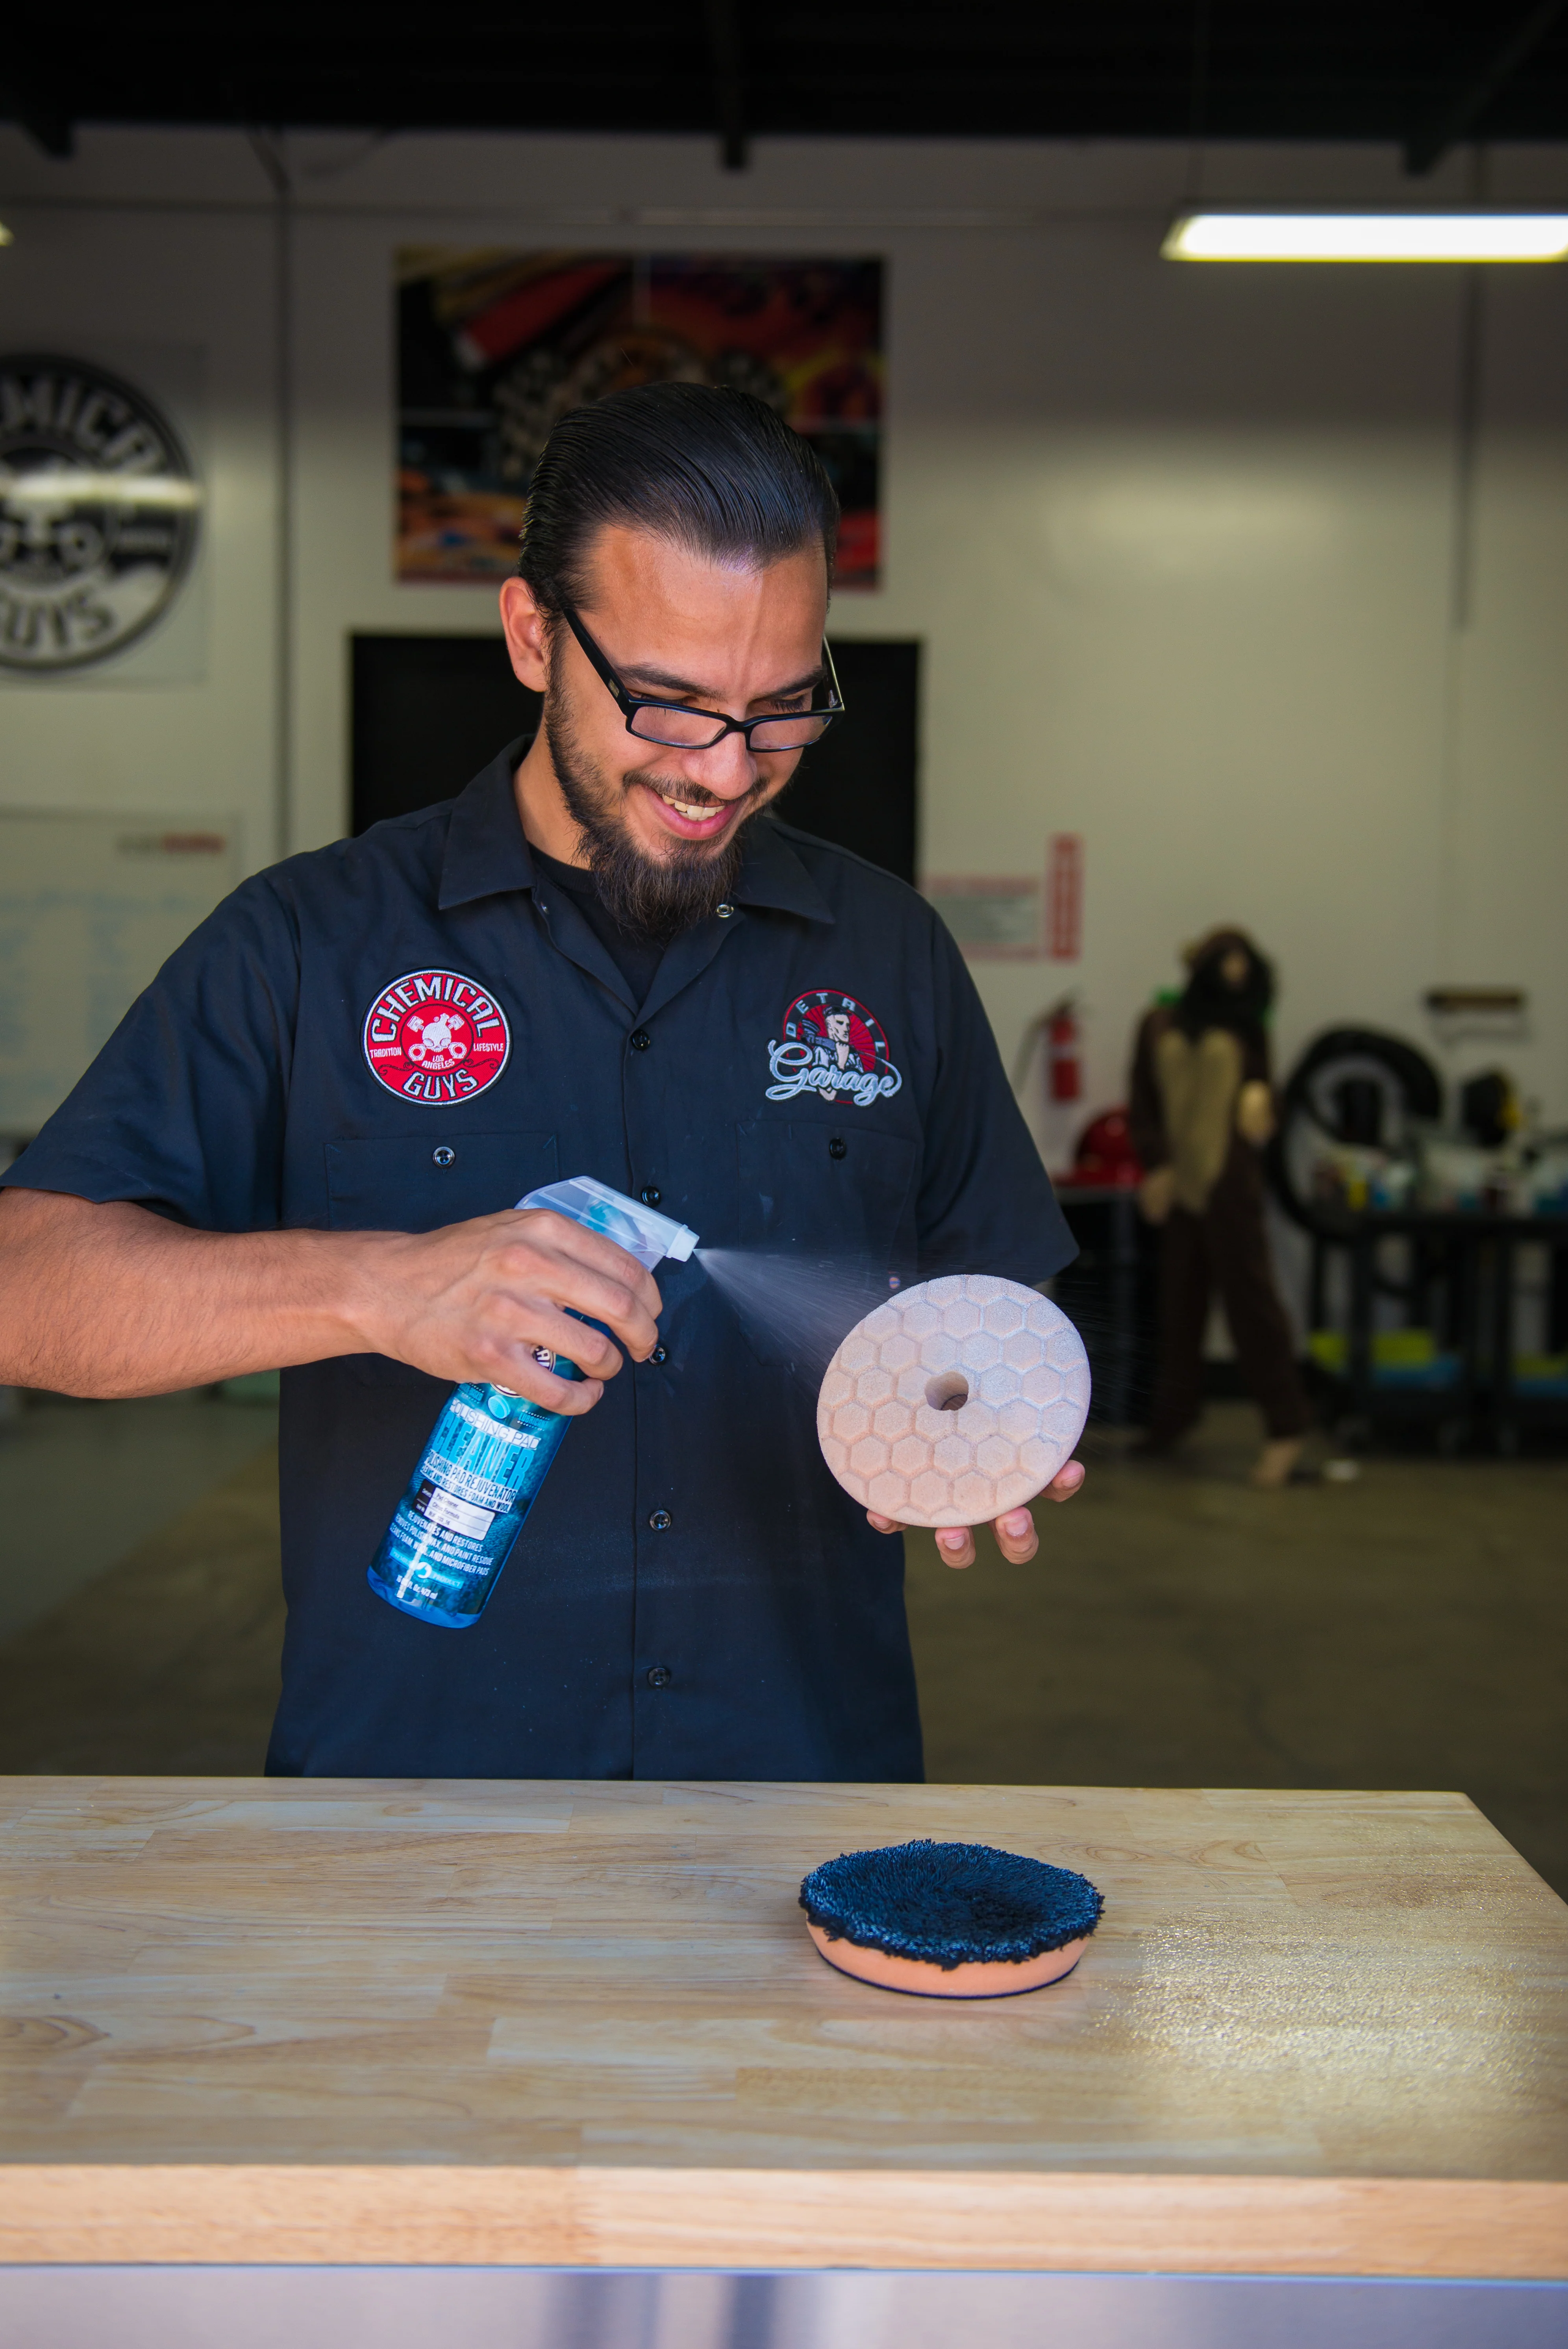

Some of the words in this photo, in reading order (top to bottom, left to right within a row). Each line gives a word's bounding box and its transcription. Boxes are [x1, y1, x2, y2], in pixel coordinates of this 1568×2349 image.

[371, 976, 500, 1042] CHEMICAL
[786, 993, 885, 1052] DETAIL
[370, 1047, 402, 1058] TRADITION
[422, 1058, 455, 1069] ANGELES
[473, 1043, 504, 1052] LIFESTYLE
[402, 1069, 479, 1099] GUYS
[765, 1040, 902, 1106] Garage
[450, 1399, 510, 1439] POLISHING
[512, 1431, 540, 1449] PAD
[431, 1410, 535, 1490] CLEANER
[441, 1478, 468, 1497] RESTORES
[467, 1491, 485, 1504] FOAM
[484, 1497, 496, 1508] AND
[496, 1502, 510, 1512] WOOL
[450, 1467, 467, 1484] PAD
[464, 1474, 516, 1502] REJUVENATOR
[407, 1510, 442, 1536] REJUVENATES
[439, 1530, 454, 1542] AND
[452, 1535, 483, 1552] RESTORES
[408, 1525, 428, 1542] POLISH
[441, 1543, 455, 1555] AND
[454, 1548, 473, 1561] PAINT
[471, 1554, 493, 1565] RESIDUE
[428, 1550, 444, 1562] AND
[441, 1555, 477, 1573] MICROFIBER
[476, 1567, 489, 1576] PADS
